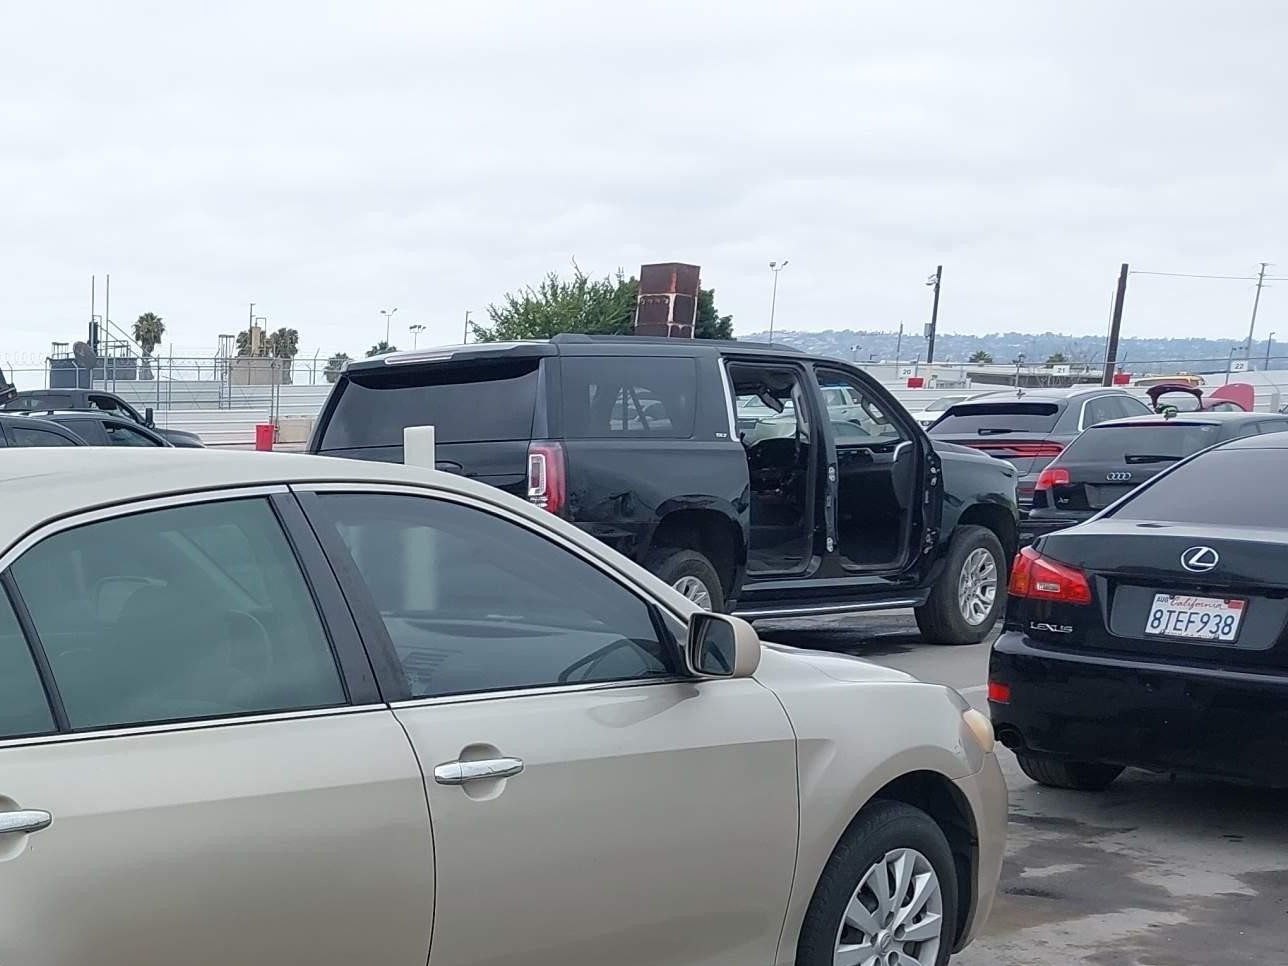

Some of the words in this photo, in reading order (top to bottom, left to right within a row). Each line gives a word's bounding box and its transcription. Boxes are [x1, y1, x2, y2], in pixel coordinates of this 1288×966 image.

[1170, 596, 1224, 611] California
[1030, 621, 1073, 634] LEXUS
[1150, 608, 1235, 636] 8TEF938
